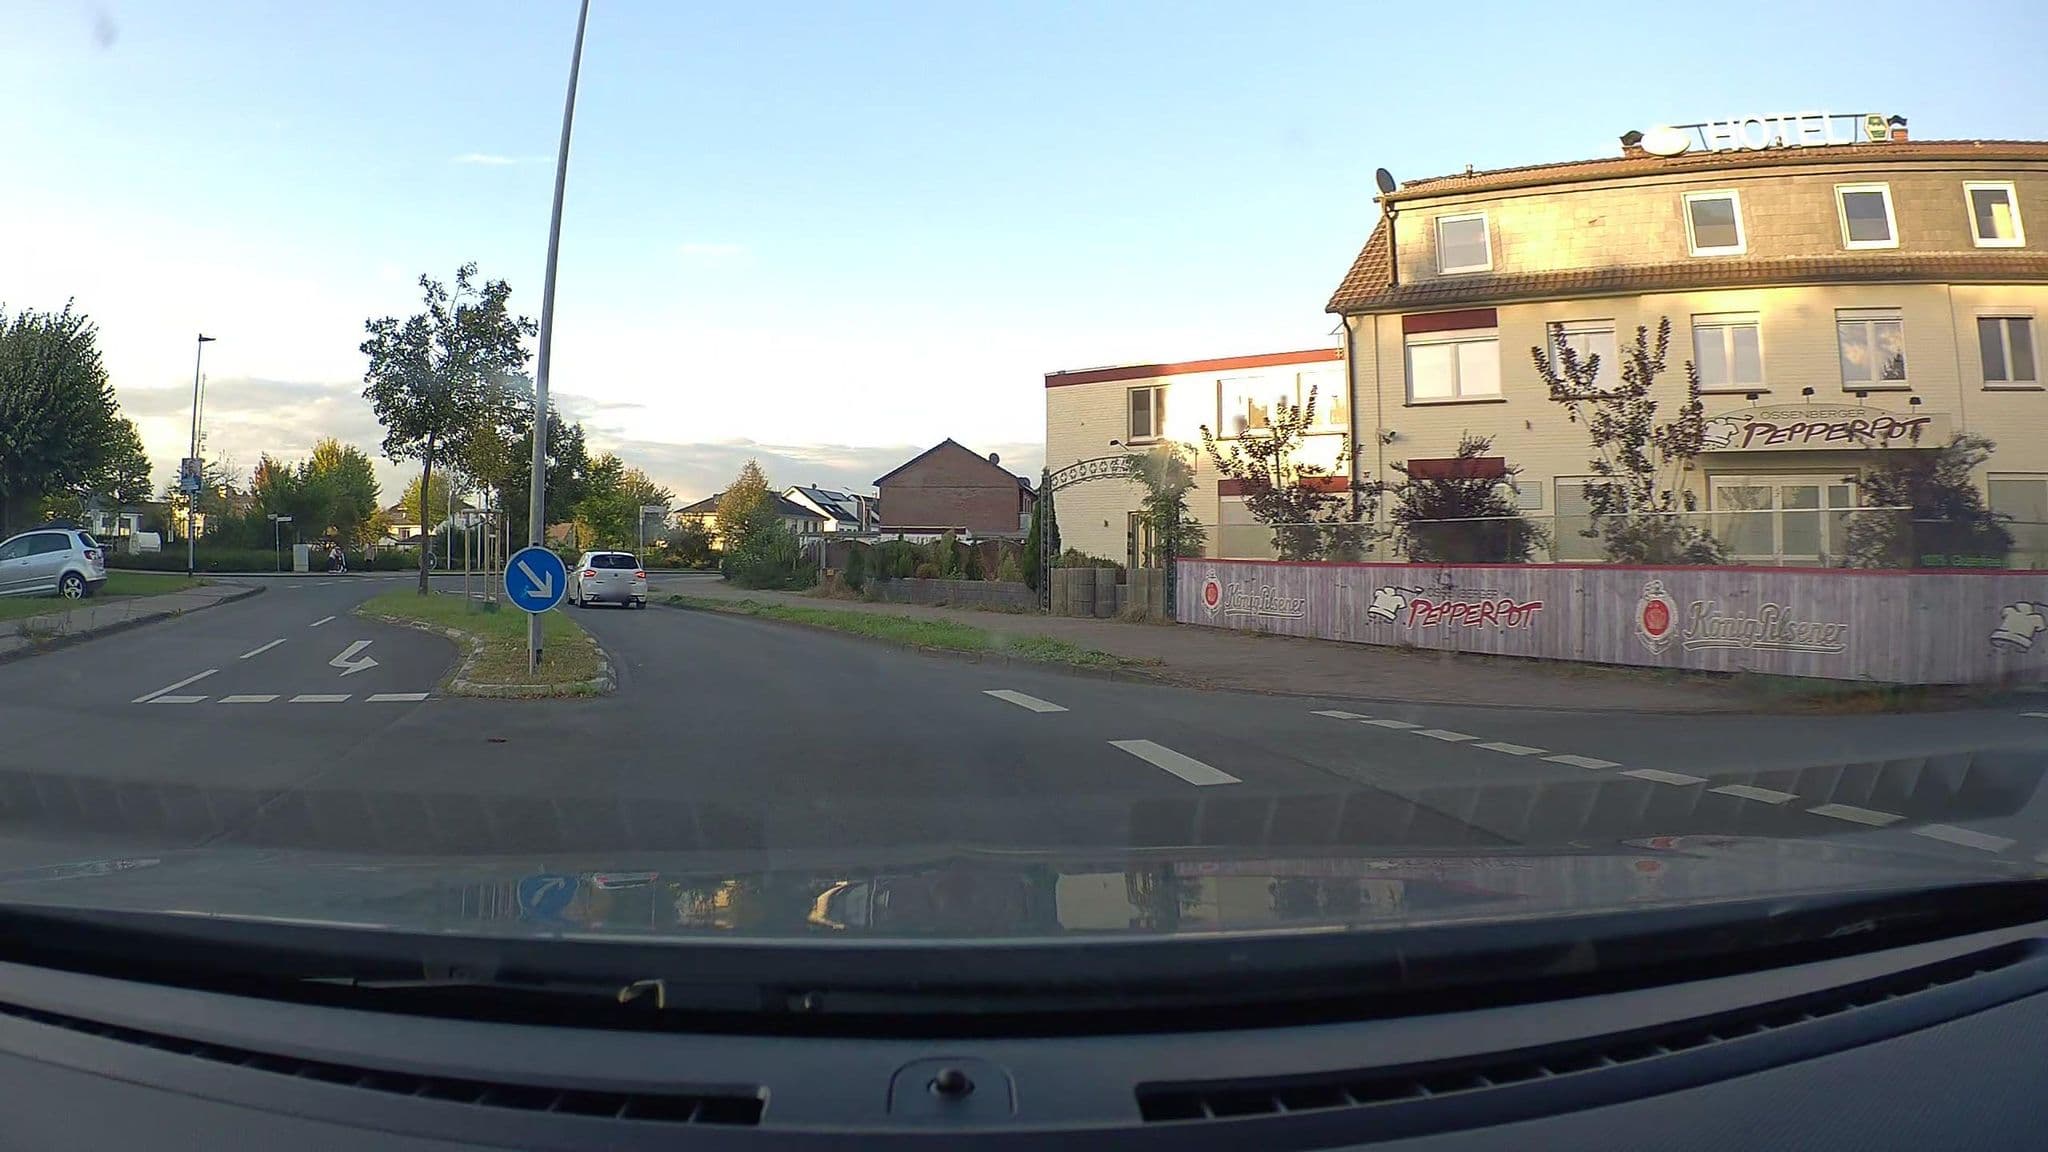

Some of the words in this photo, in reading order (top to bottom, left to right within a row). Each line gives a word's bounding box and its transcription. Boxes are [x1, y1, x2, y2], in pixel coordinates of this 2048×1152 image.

[1708, 113, 1851, 153] HOTEL
[1760, 409, 1866, 420] OSSENBERGER
[1741, 416, 1931, 449] PEPPERPOT
[1260, 585, 1305, 613] Pilsener
[1407, 598, 1544, 630] PEPPERPOT
[1683, 600, 1757, 648] König
[1756, 602, 1848, 647] Pilsener
